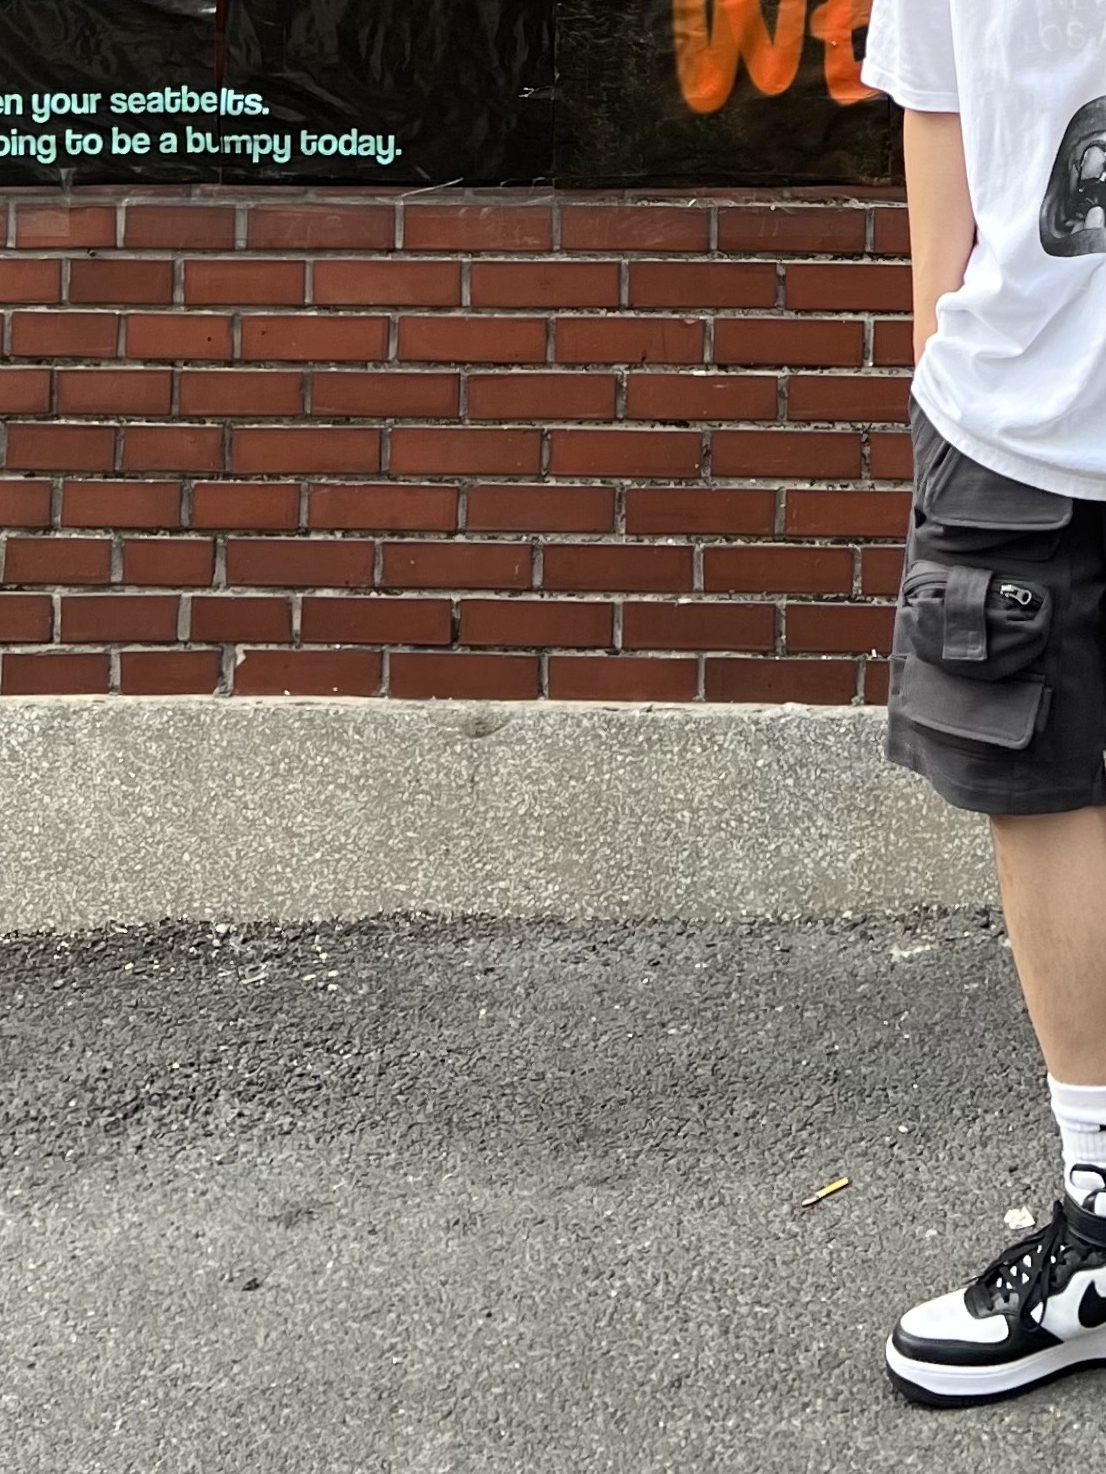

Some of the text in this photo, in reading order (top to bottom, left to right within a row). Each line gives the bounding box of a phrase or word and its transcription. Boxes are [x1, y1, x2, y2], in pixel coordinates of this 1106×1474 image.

[0, 85, 270, 124] n your seatbelts.
[65, 128, 103, 156] to
[111, 126, 150, 155] be
[158, 131, 178, 154] a
[185, 126, 292, 164] bumpy
[300, 128, 403, 166] today.
